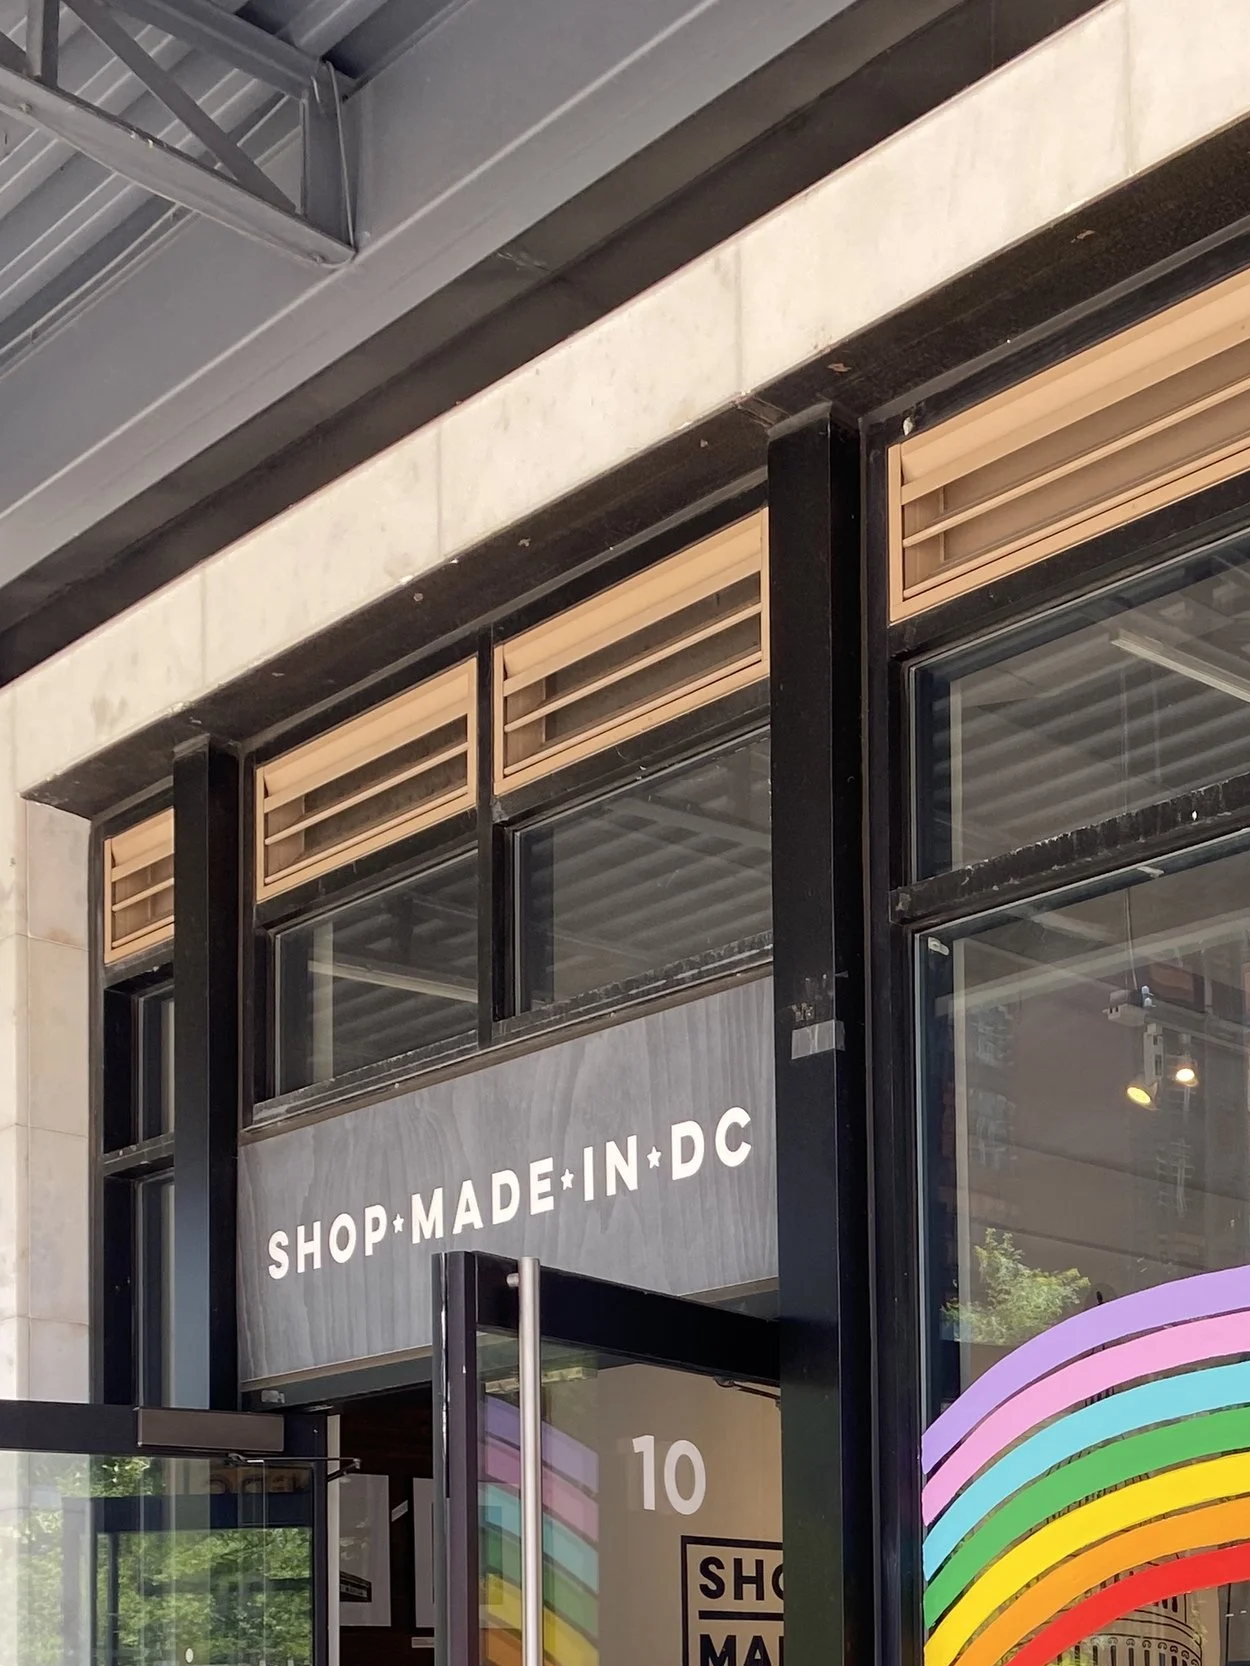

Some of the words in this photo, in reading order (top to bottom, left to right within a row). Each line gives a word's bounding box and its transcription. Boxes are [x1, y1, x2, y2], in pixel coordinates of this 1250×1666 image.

[267, 1204, 388, 1280] SHOP
[411, 1156, 556, 1244] MADE
[583, 1135, 640, 1201] IN
[670, 1106, 753, 1181] DC
[632, 1434, 707, 1516] 10
